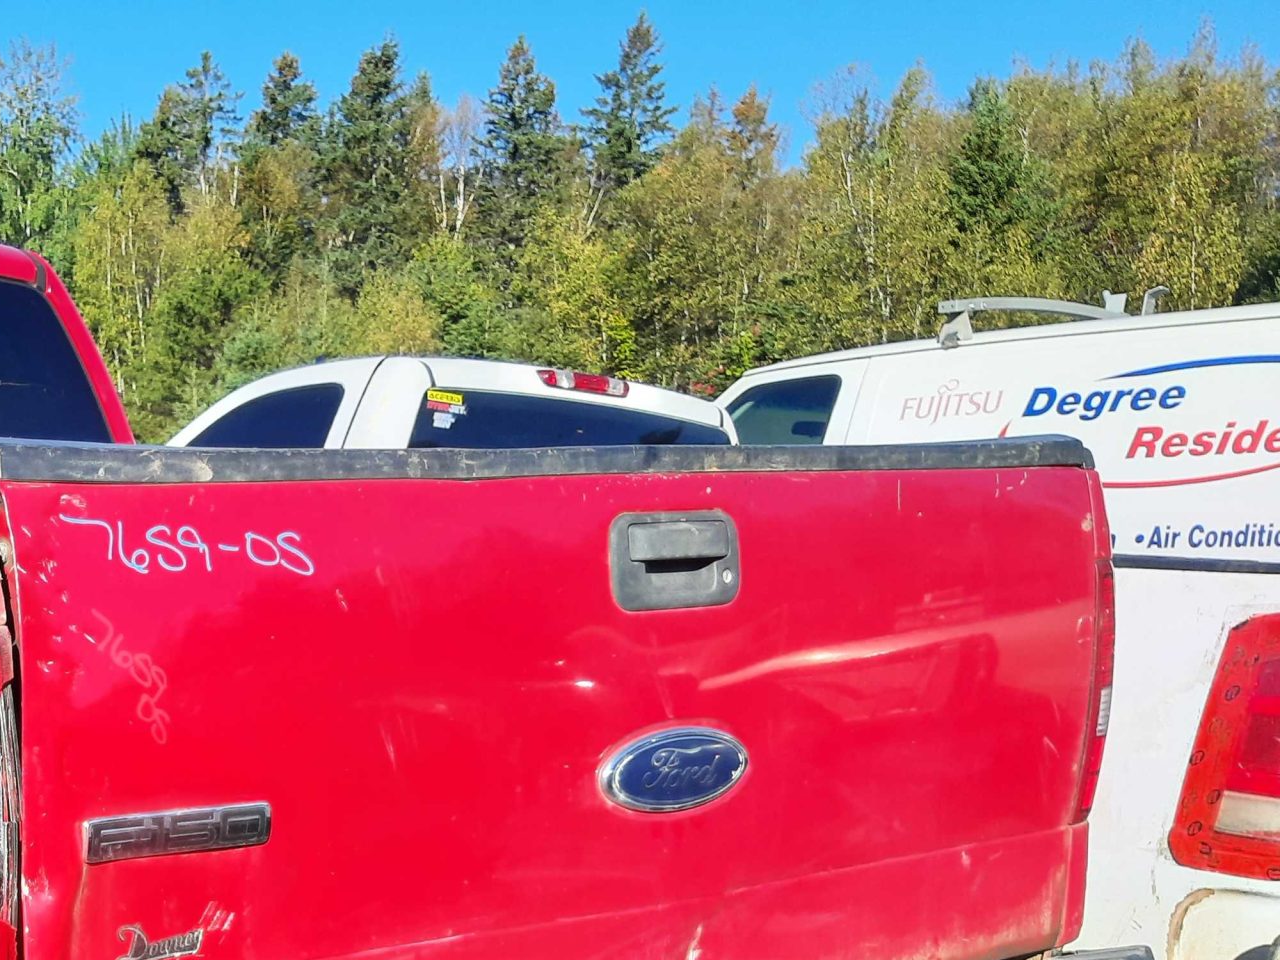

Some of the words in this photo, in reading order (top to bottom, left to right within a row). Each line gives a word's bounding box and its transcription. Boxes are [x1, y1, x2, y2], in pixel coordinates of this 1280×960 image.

[899, 379, 1004, 425] FUJITSU
[1021, 385, 1186, 421] Degree
[1125, 419, 1280, 459] Reside
